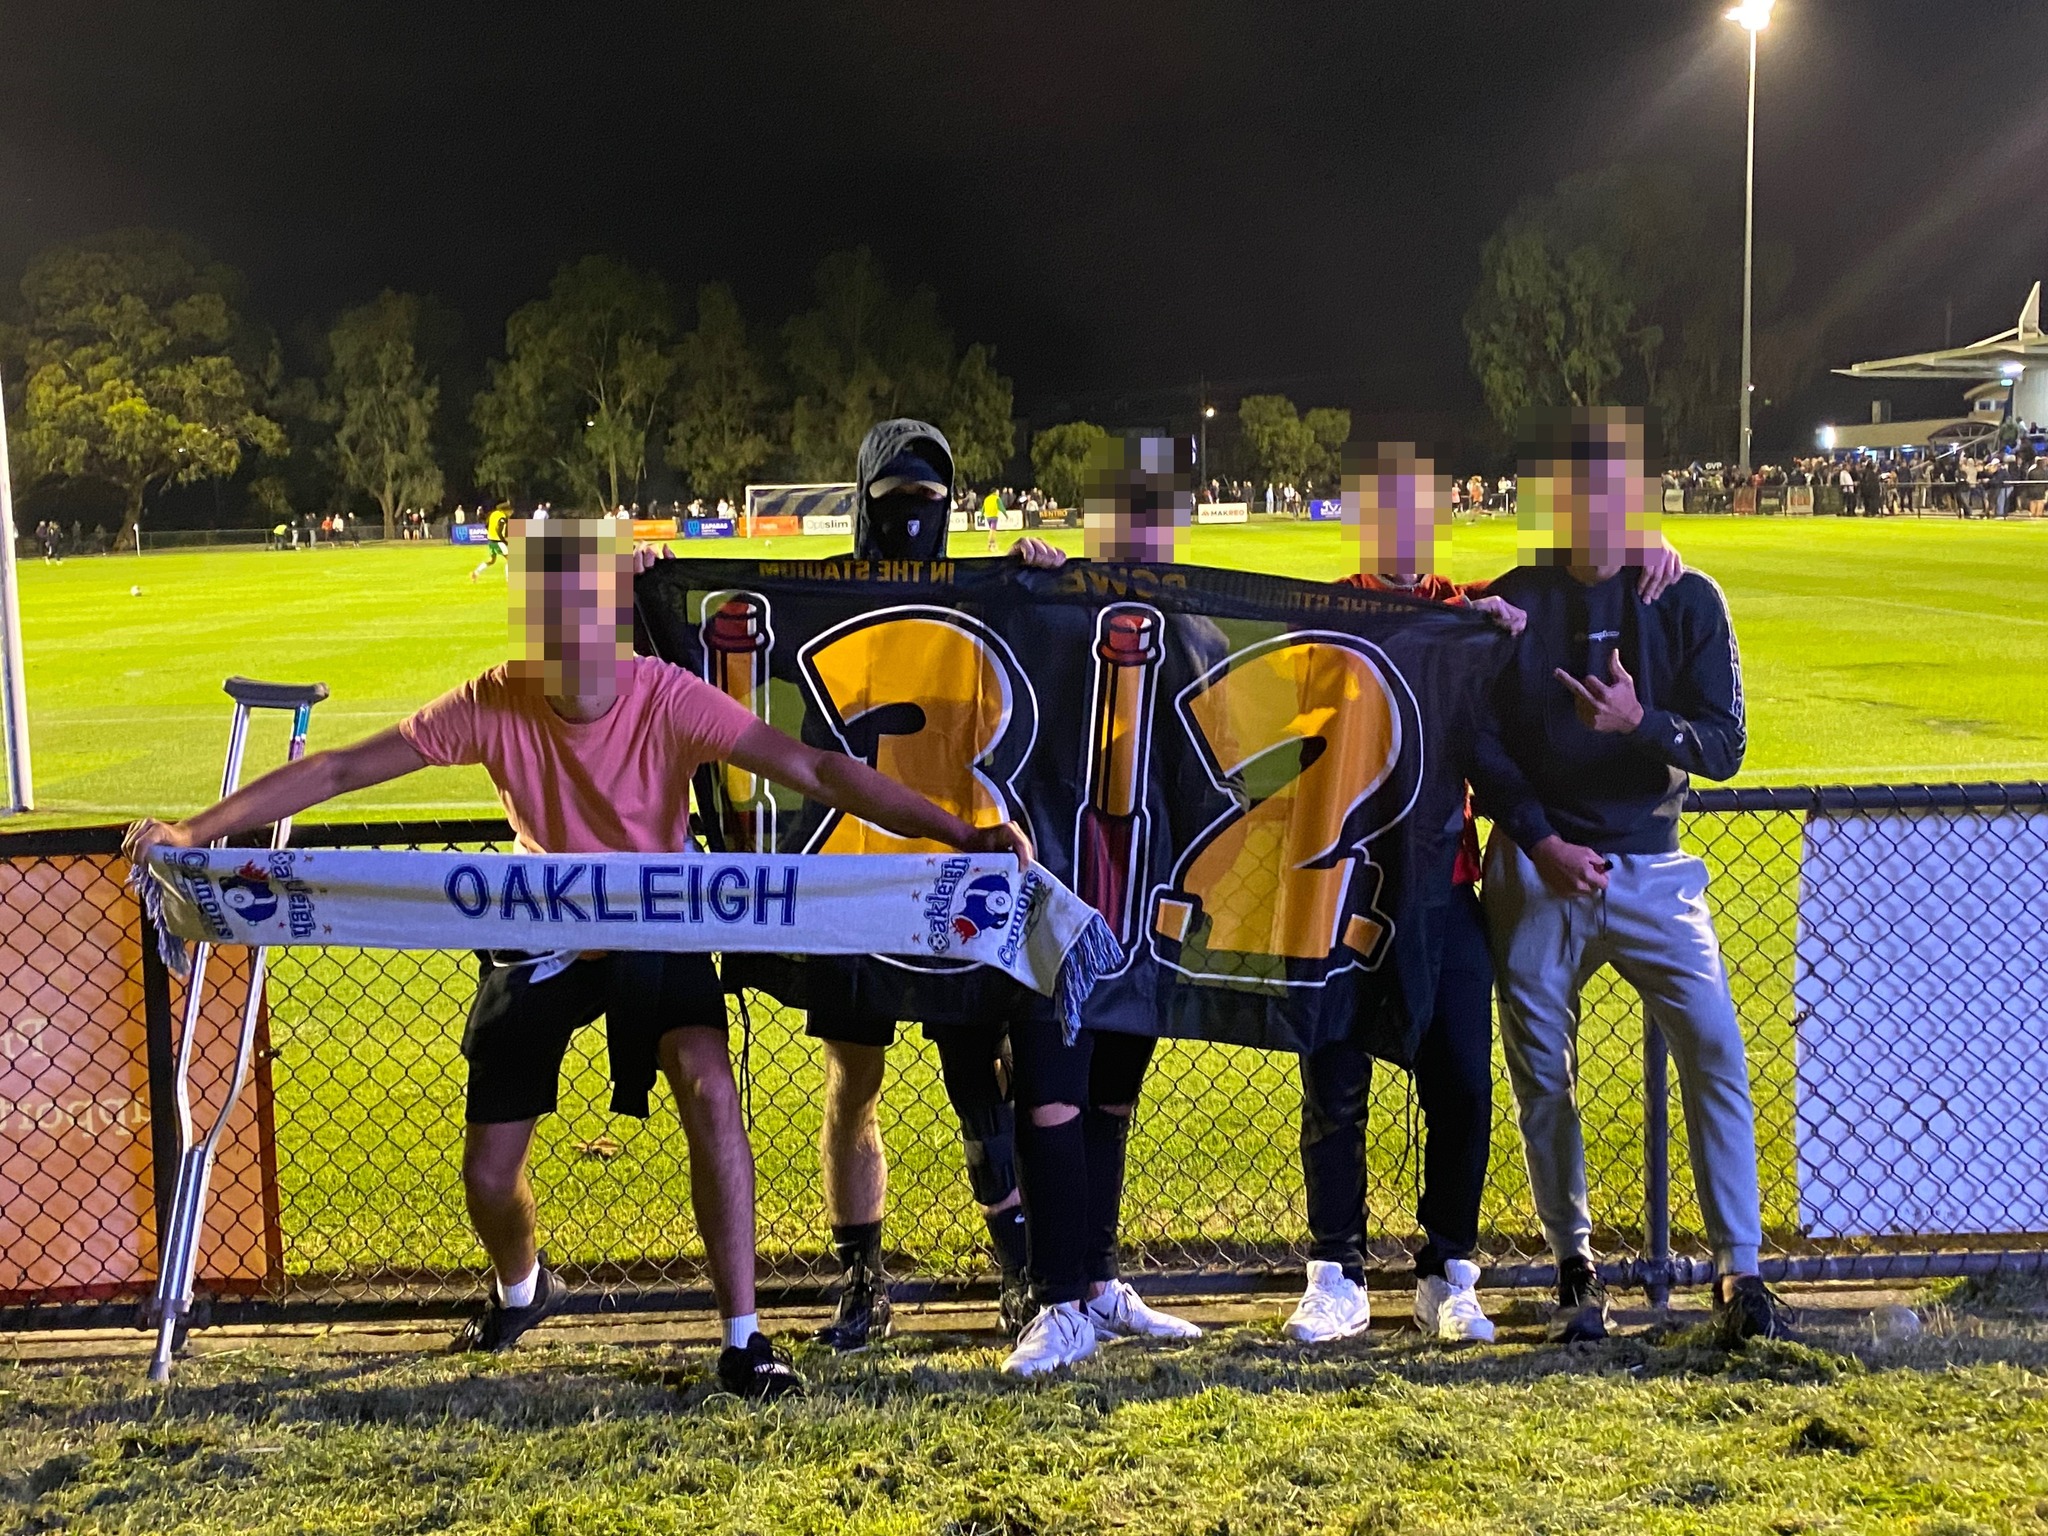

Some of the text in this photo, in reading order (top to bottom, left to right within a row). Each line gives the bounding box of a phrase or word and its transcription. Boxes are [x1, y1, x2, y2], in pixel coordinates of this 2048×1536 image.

[806, 519, 849, 530] Optislim
[444, 863, 799, 926] OAKLEIGH
[923, 857, 971, 952] Oakleigh
